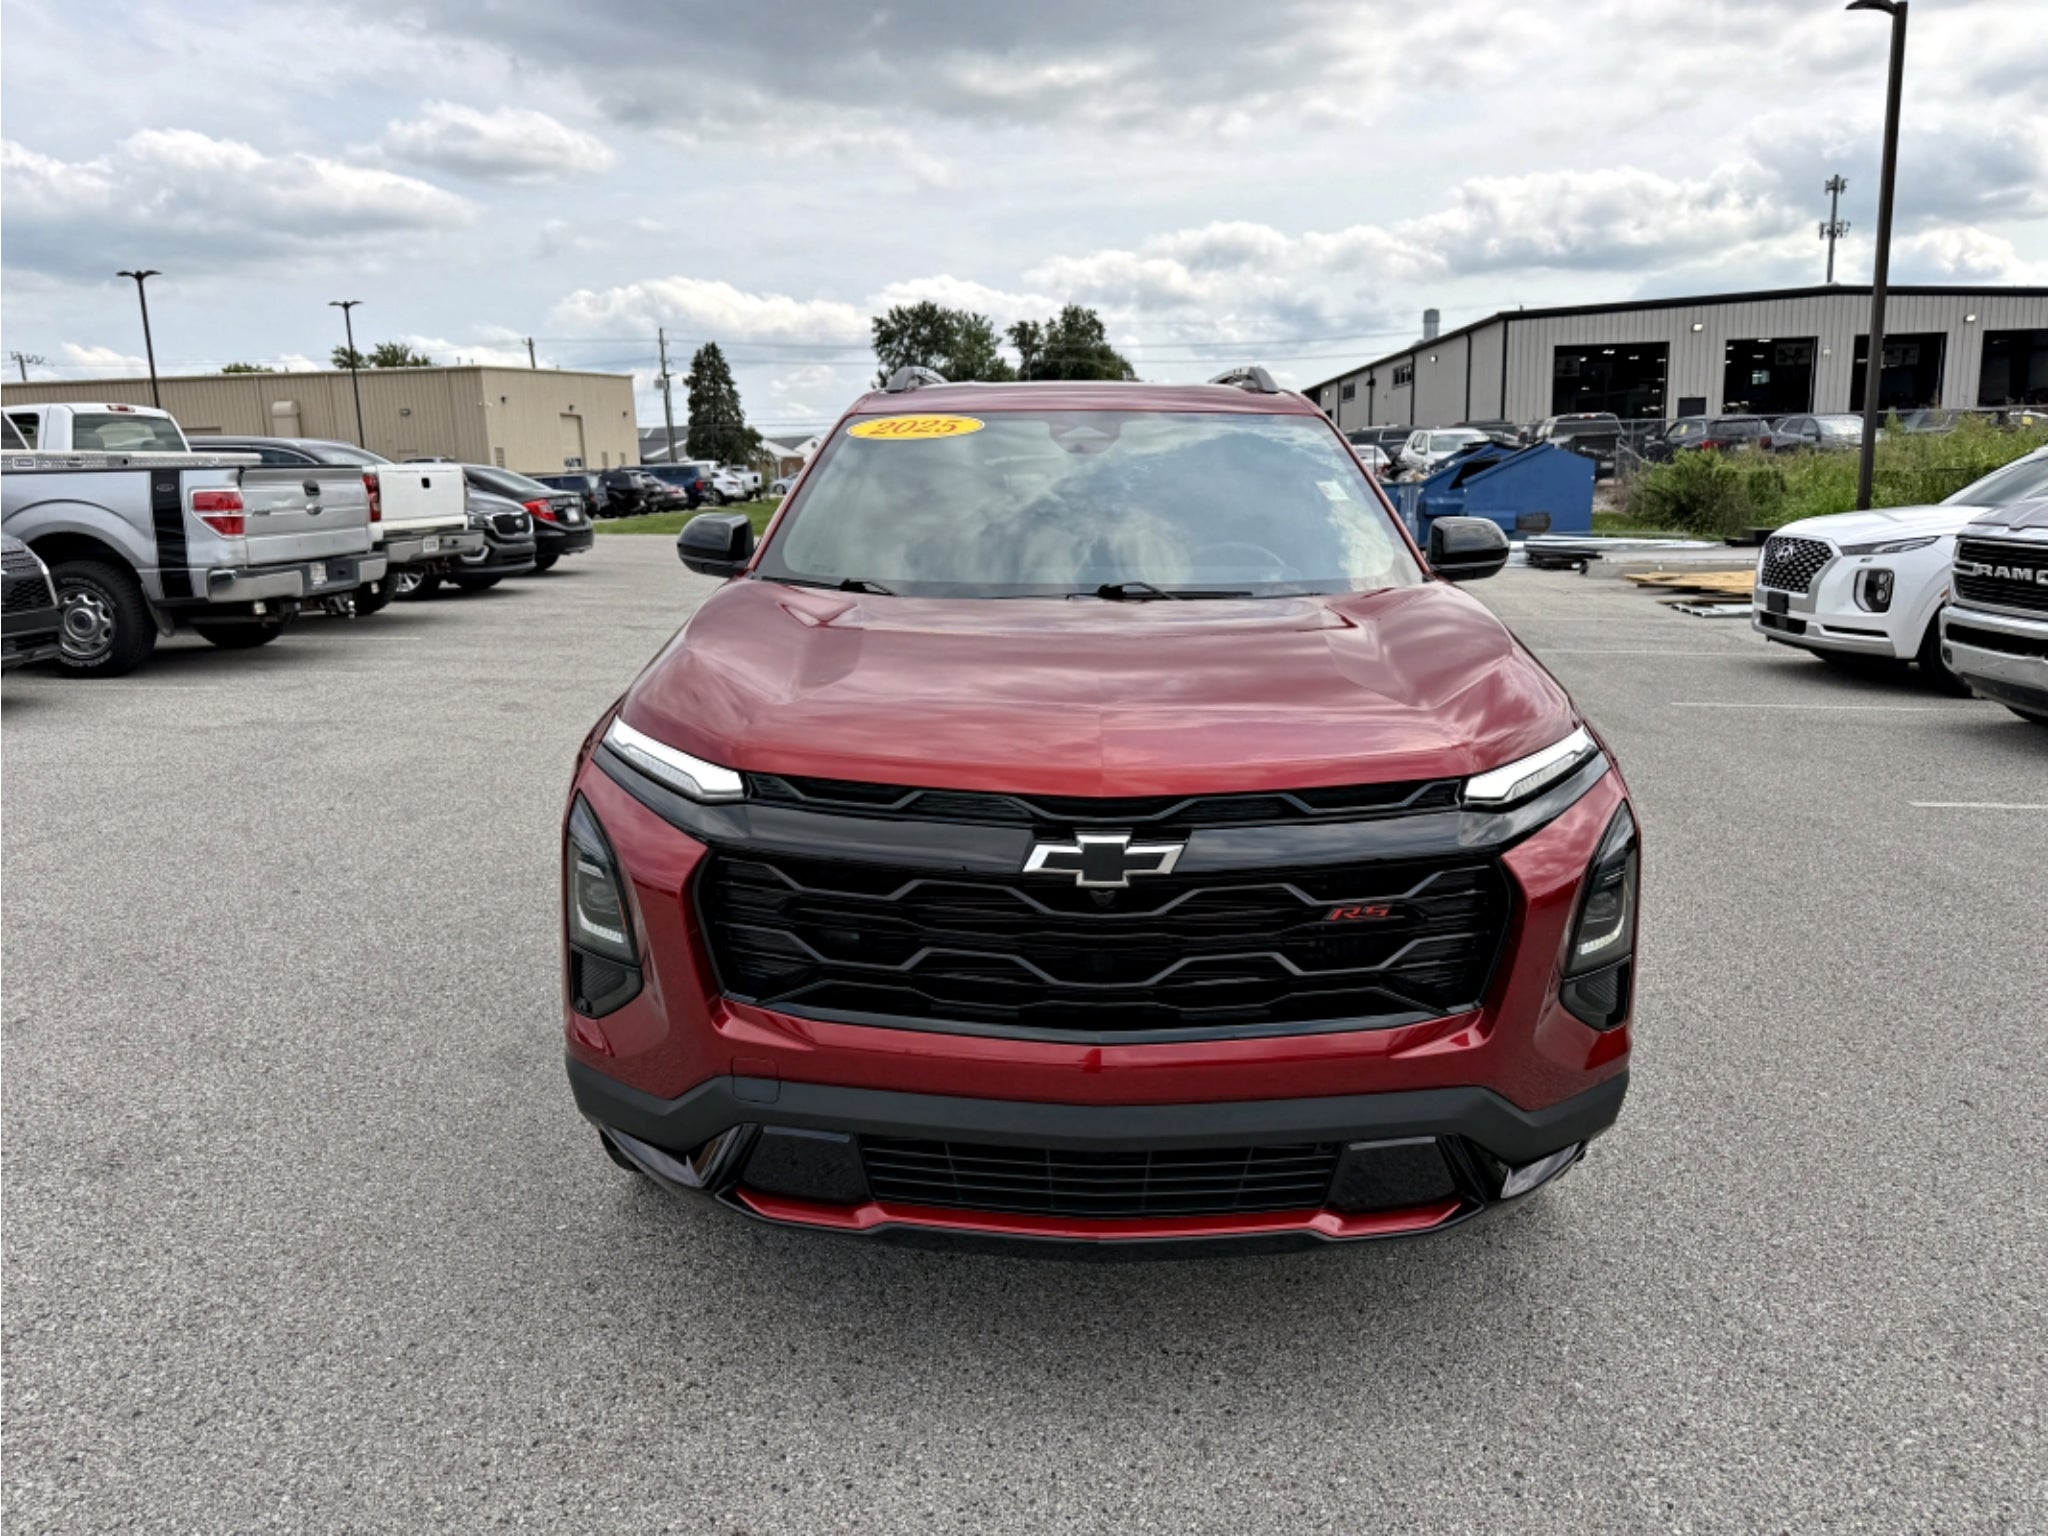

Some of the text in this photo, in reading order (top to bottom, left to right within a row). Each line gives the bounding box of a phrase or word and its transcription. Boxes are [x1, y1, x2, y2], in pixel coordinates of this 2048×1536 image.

[868, 419, 963, 435] 2025
[1978, 563, 2033, 581] RAM
[1327, 904, 1389, 922] RS
